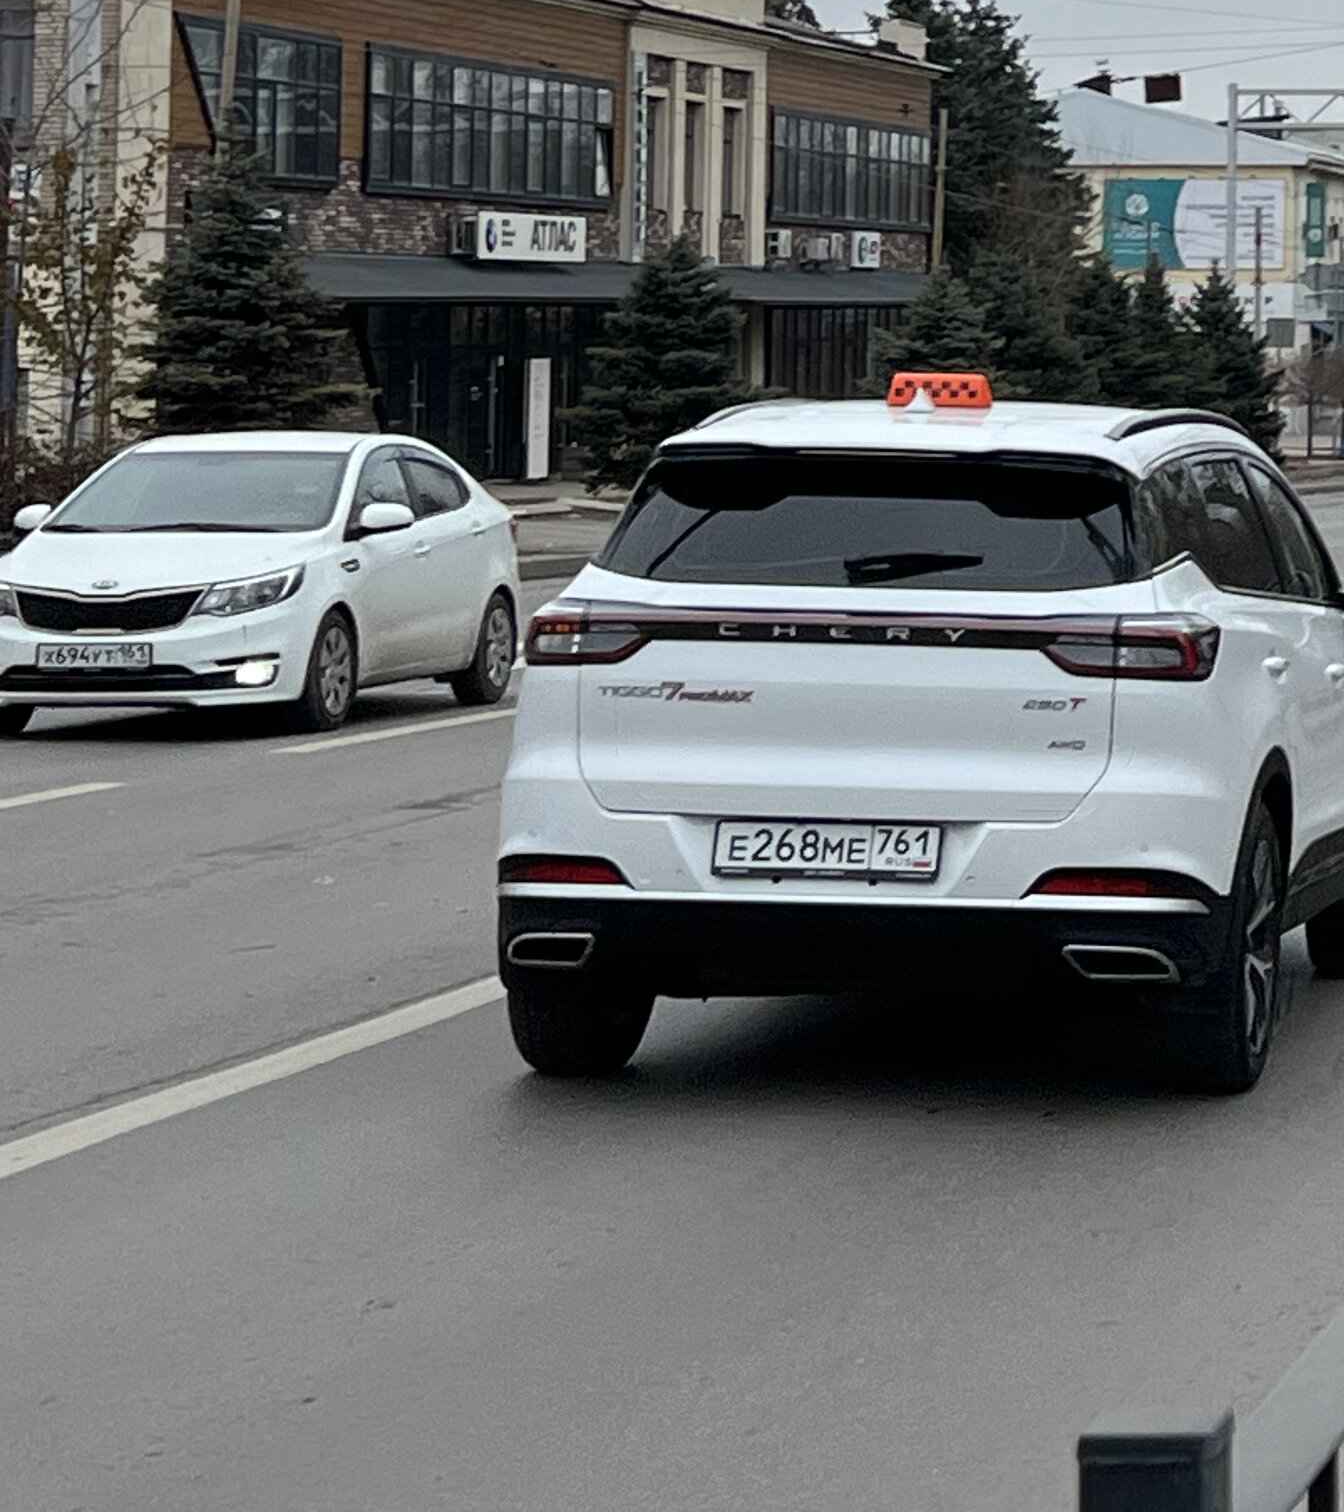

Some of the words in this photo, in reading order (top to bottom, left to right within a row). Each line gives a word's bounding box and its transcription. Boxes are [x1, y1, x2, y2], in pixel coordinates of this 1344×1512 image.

[530, 219, 577, 253] АТЛАС
[718, 624, 968, 643] CHERY
[877, 828, 931, 856] 761
